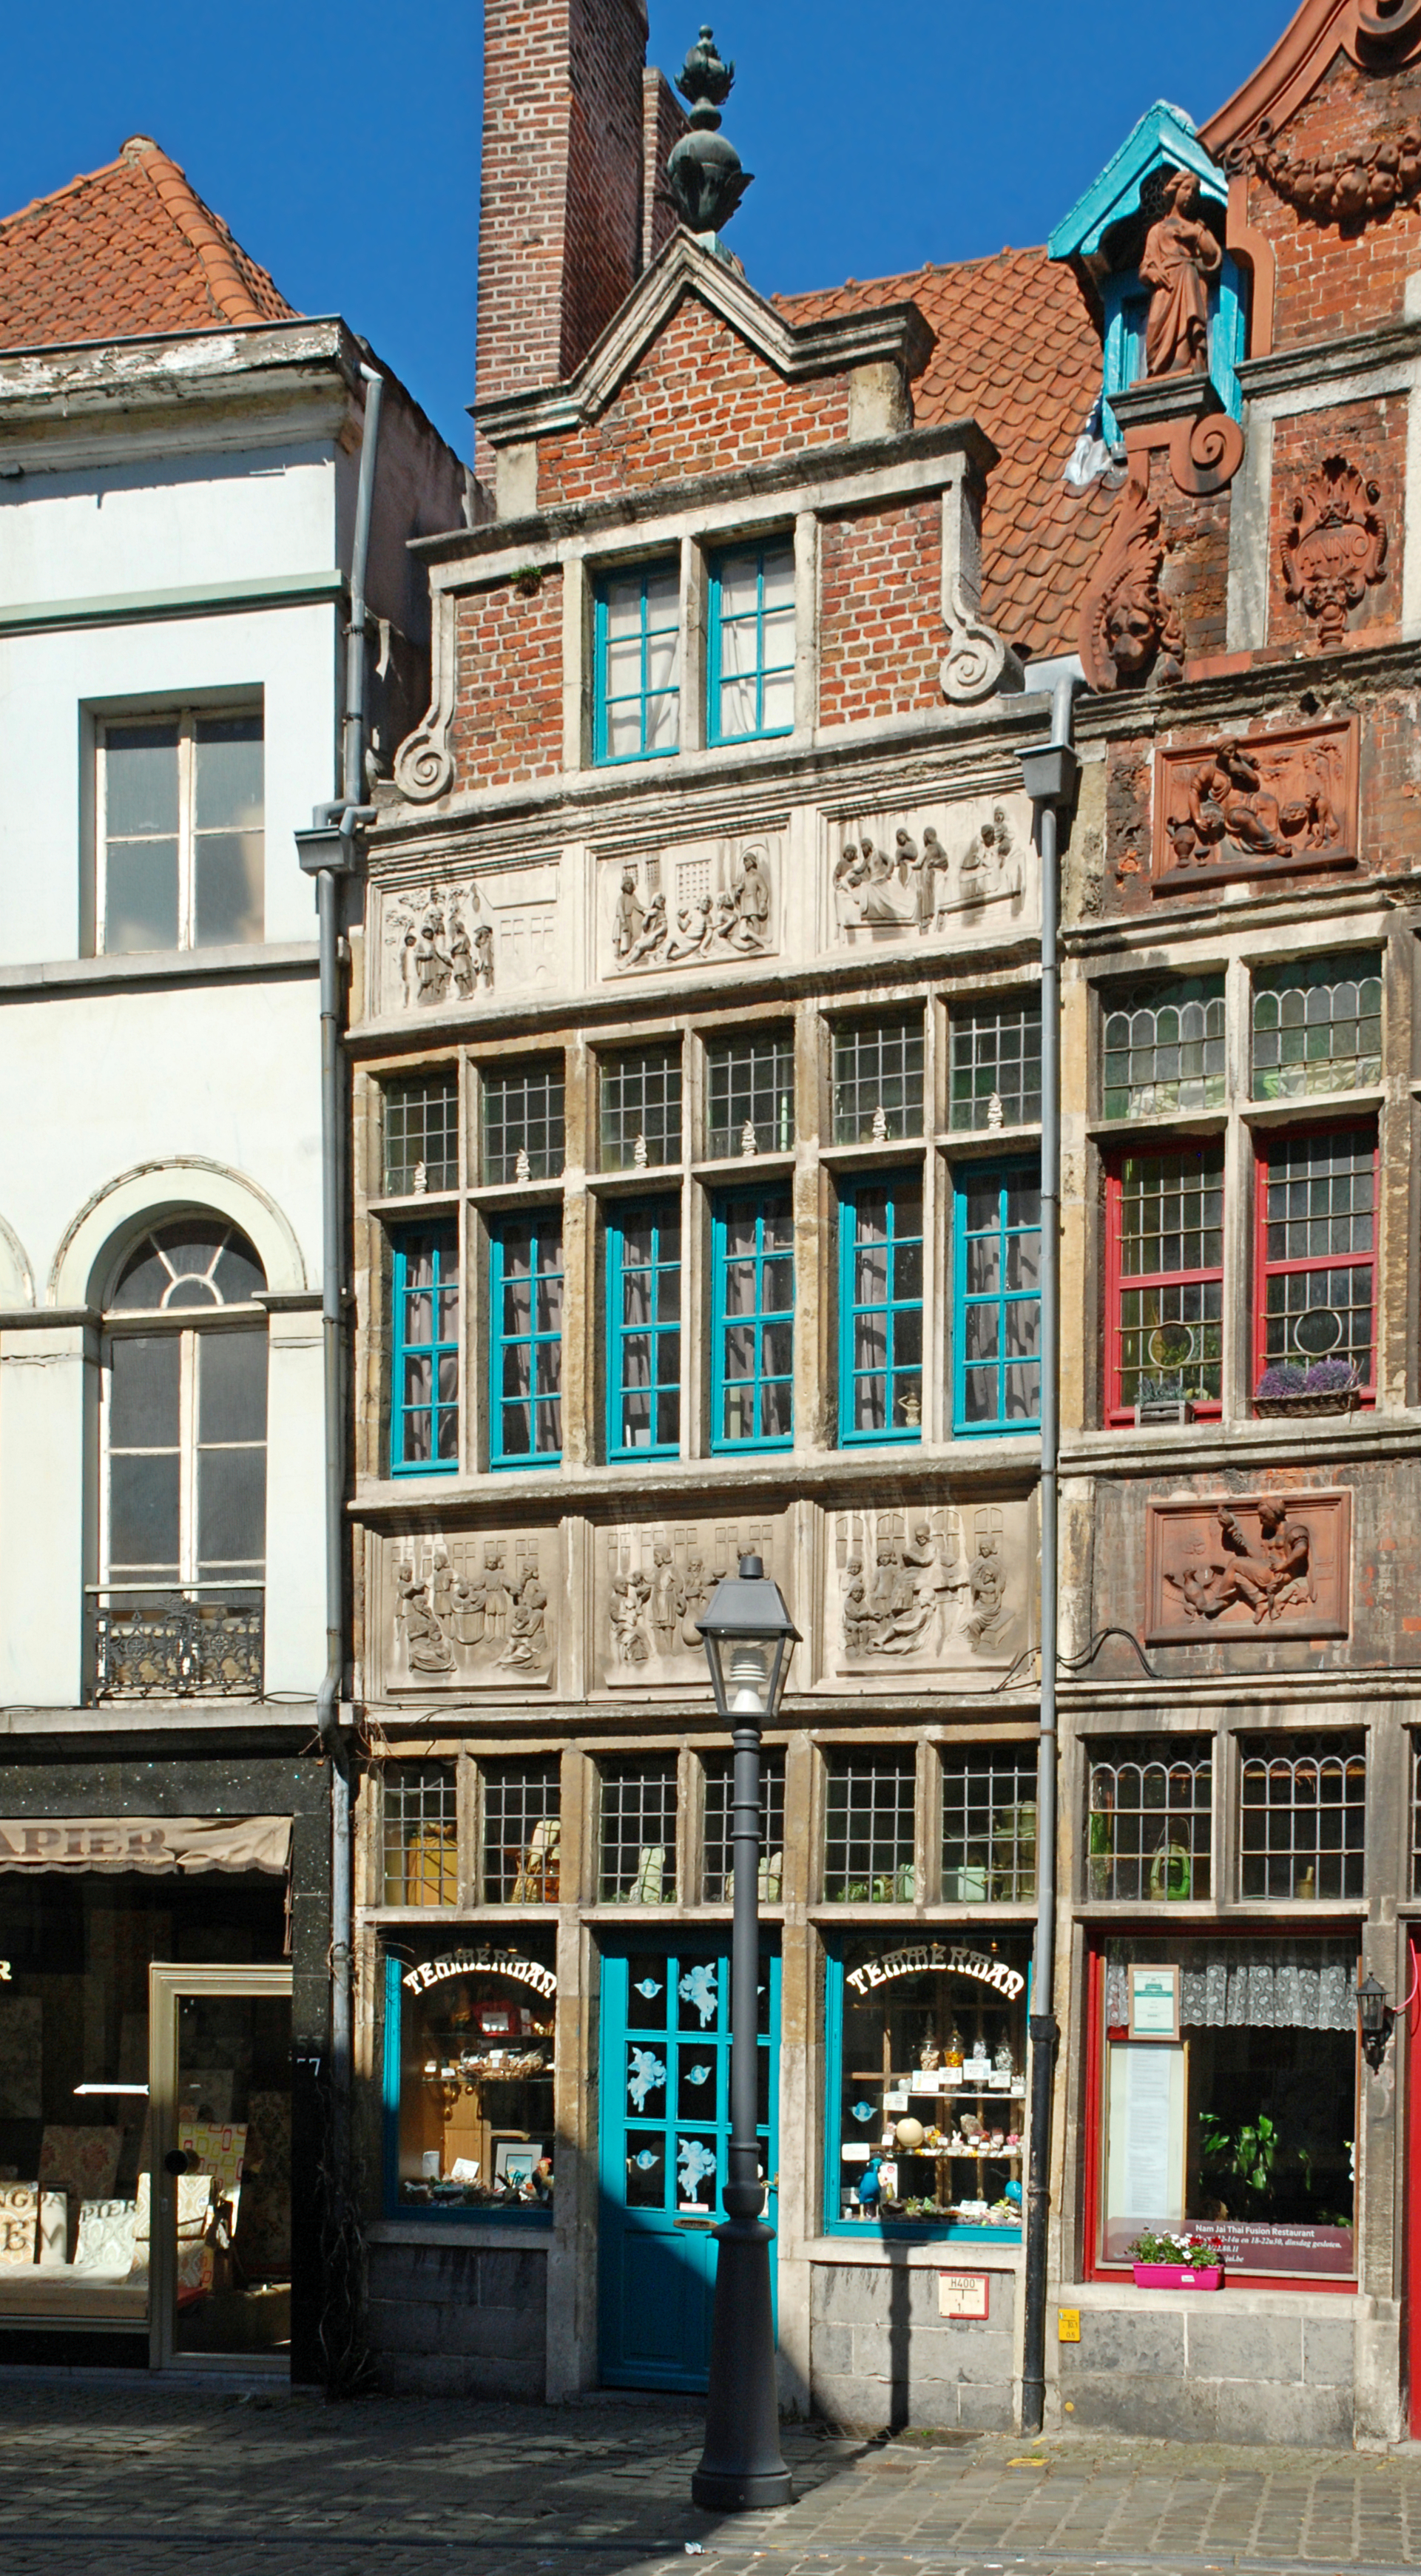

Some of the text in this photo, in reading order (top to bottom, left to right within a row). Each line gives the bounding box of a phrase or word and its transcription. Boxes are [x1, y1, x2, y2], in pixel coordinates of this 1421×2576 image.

[402, 1948, 557, 1998] TEMMERMAN
[846, 1945, 1025, 2000] TEMMERMAN
[1195, 2224, 1314, 2238] Nam Jai Thai Fusion Restaurant
[1285, 2239, 1312, 2248] dinsdag
[1312, 2239, 1342, 2248] gesloten.
[951, 2278, 976, 2288] H400
